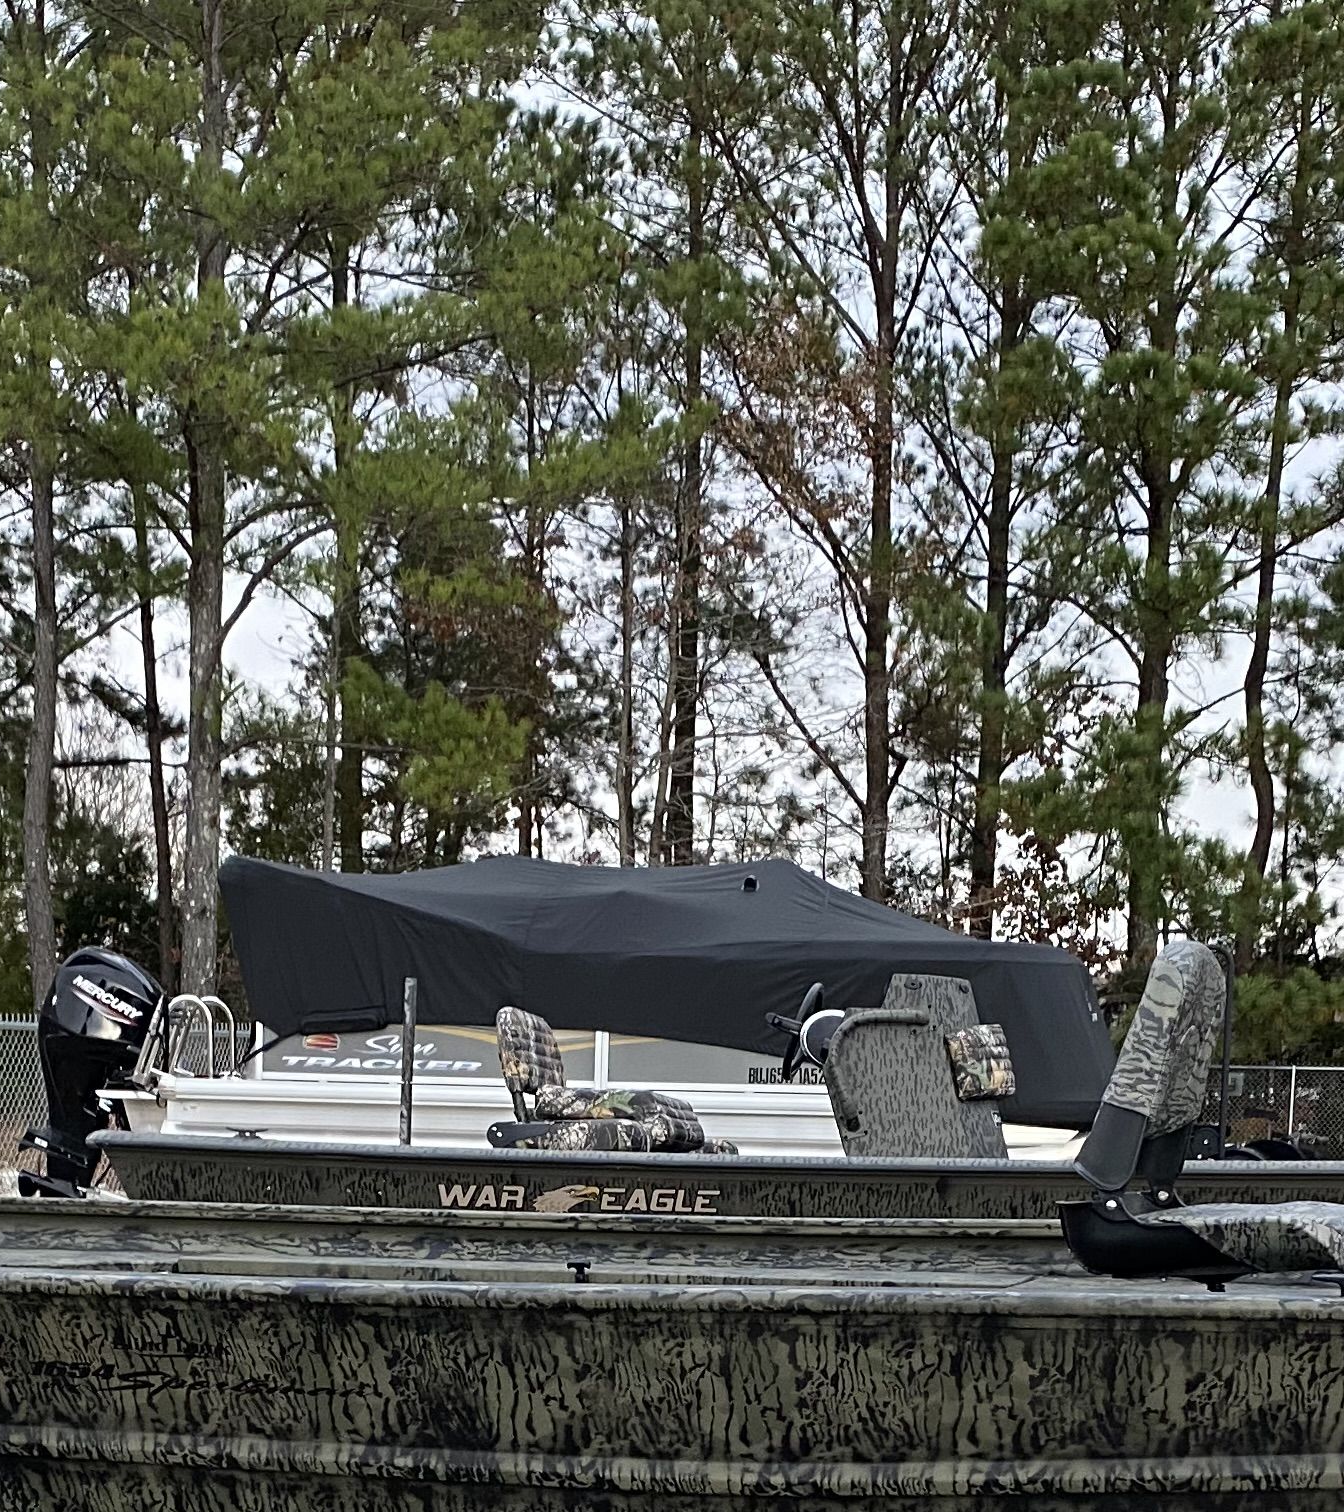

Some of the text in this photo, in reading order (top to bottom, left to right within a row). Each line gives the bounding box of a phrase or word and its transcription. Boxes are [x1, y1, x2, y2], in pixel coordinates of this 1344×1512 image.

[73, 974, 143, 1019] MERCURY
[281, 1055, 483, 1072] TRACKER
[437, 1184, 721, 1213] WAR EAGLE
